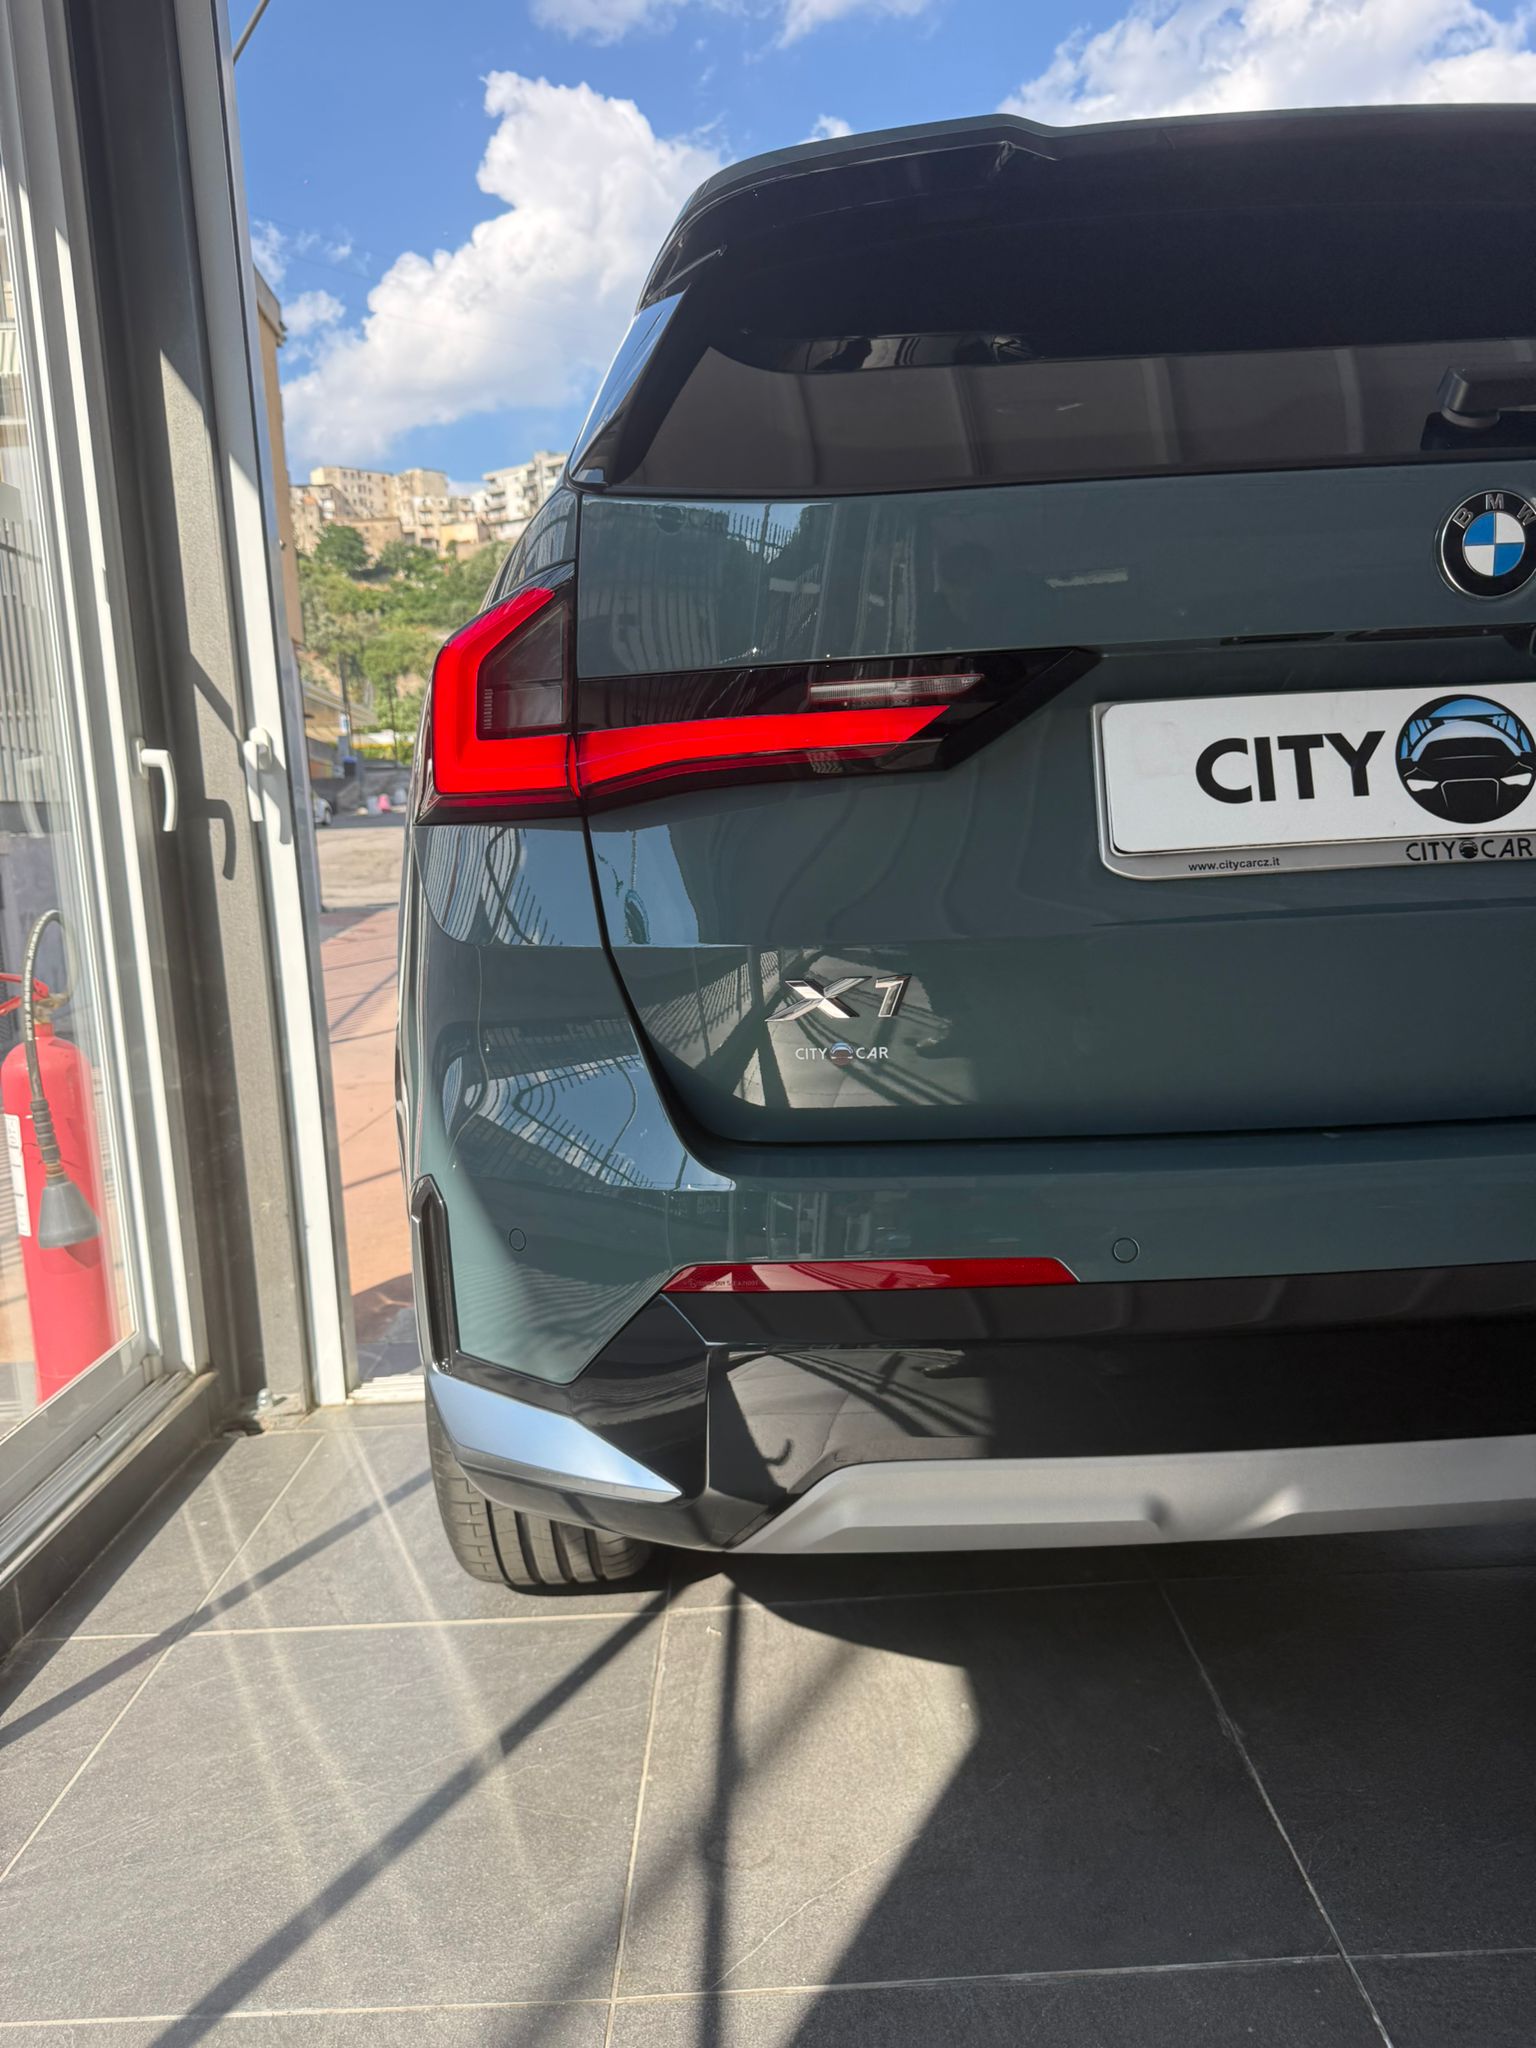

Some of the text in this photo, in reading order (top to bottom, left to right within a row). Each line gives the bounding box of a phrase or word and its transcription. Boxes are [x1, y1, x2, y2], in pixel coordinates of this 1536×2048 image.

[1452, 493, 1536, 529] BMW
[1195, 730, 1386, 804] CITY
[1188, 856, 1280, 871] www.citycarcz.it
[1406, 838, 1533, 861] CITY CAR
[764, 974, 912, 1021] X1
[795, 1047, 889, 1060] CITY CAR
